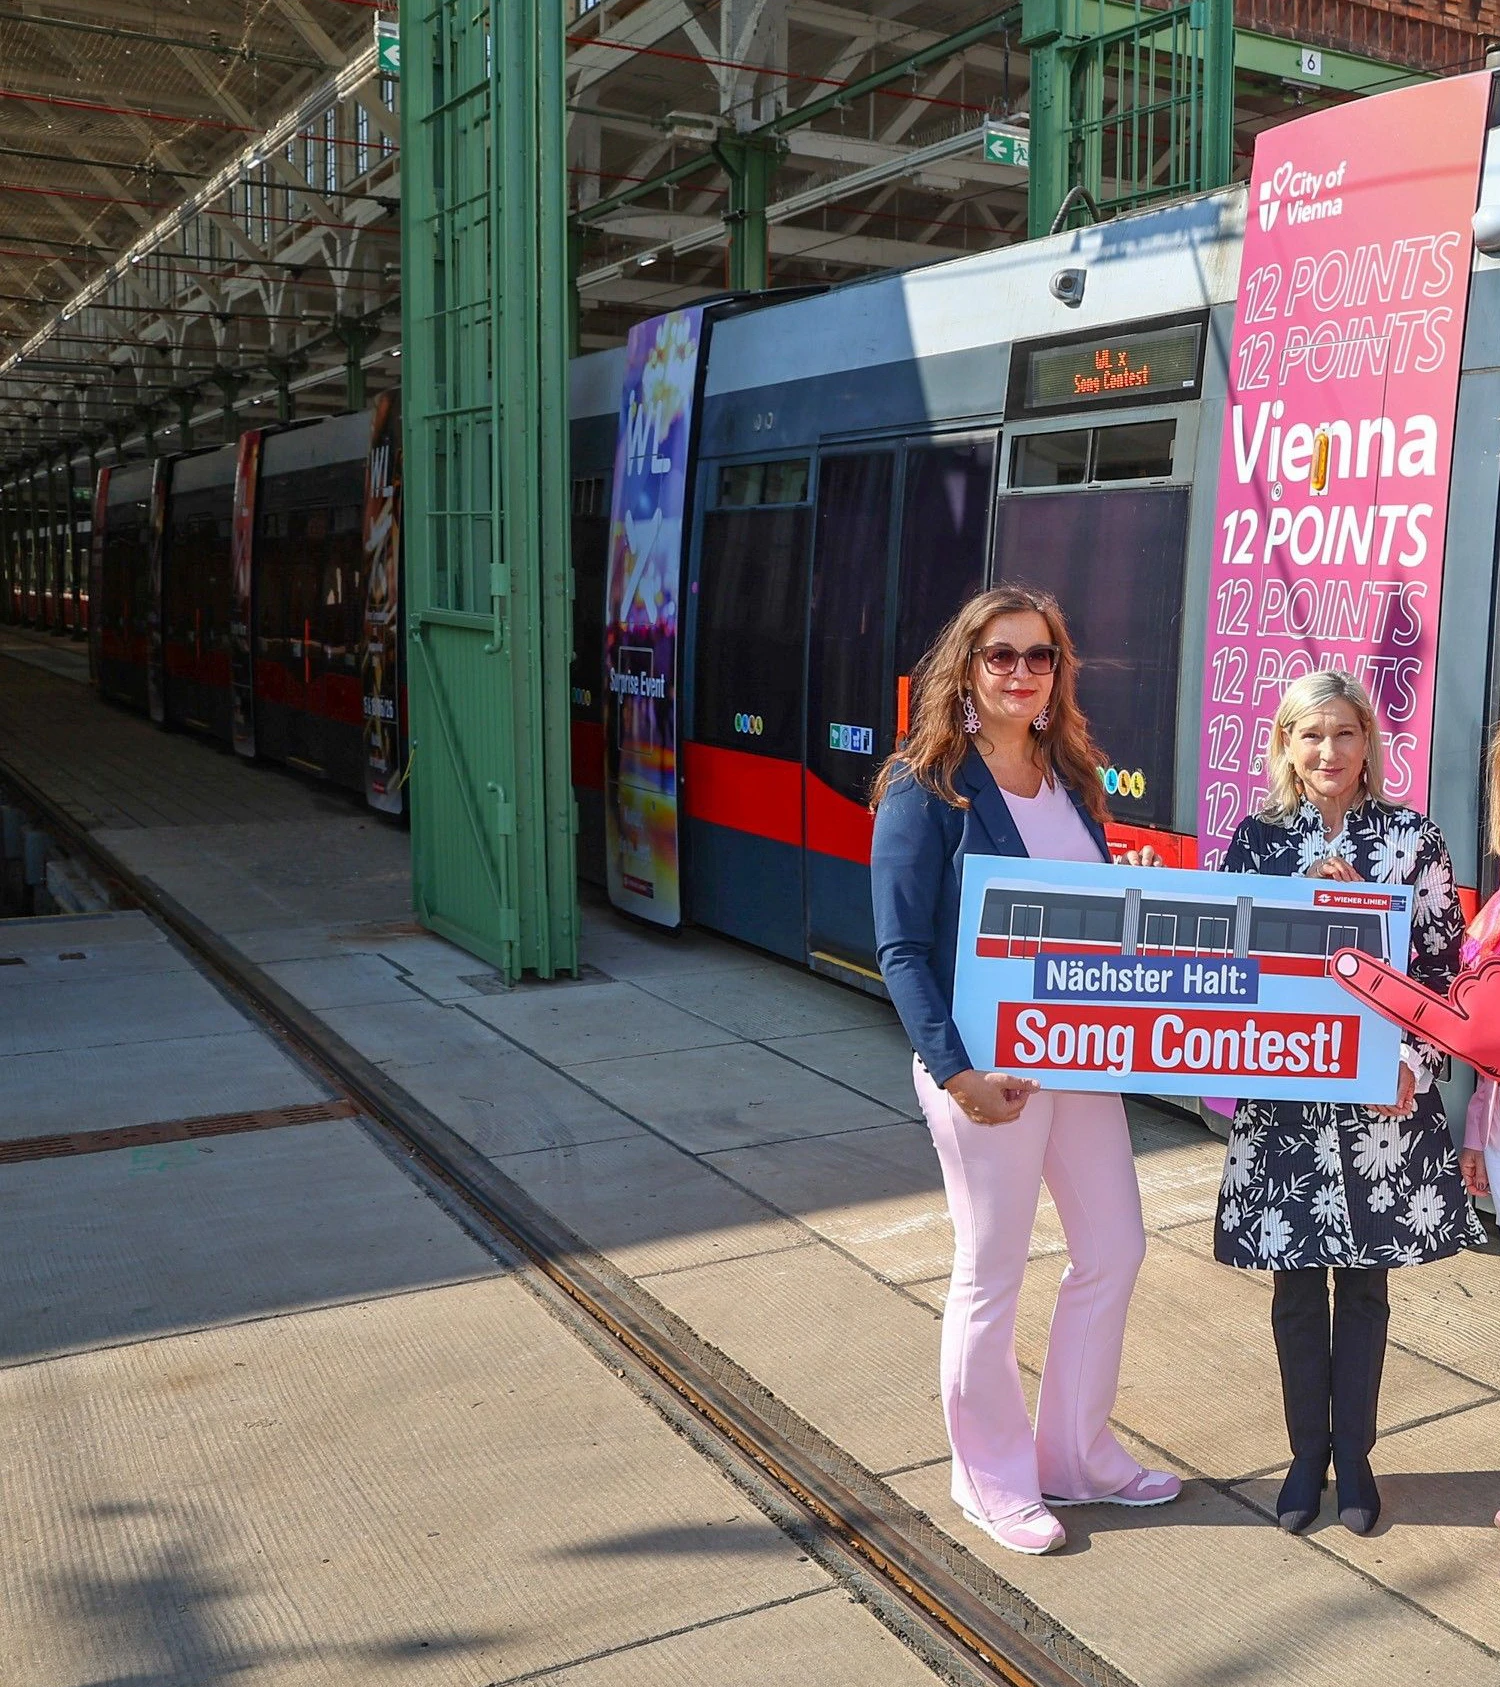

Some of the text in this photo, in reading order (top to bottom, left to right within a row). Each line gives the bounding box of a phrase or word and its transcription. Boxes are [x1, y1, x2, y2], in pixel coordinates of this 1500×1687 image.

[1307, 54, 1316, 71] 6
[1289, 160, 1347, 200] City of
[1287, 198, 1343, 226] Vienna
[1244, 231, 1460, 325] 12 POINTS
[1237, 306, 1452, 391] 12 POINTS
[1074, 365, 1149, 393] Song Contest
[627, 391, 671, 476] WL
[1233, 400, 1438, 483] Vienna
[1222, 503, 1434, 567] 12 POINTS
[1217, 578, 1428, 646] 12 POINTS
[641, 671, 665, 698] Event
[1212, 646, 1249, 704] 12
[1208, 714, 1244, 772] 12
[1205, 781, 1240, 840] 12
[1334, 896, 1387, 906] WIENER LINIEN
[1046, 960, 1247, 995] Nächster Halt:
[1014, 1009, 1343, 1077] Song Contest!
